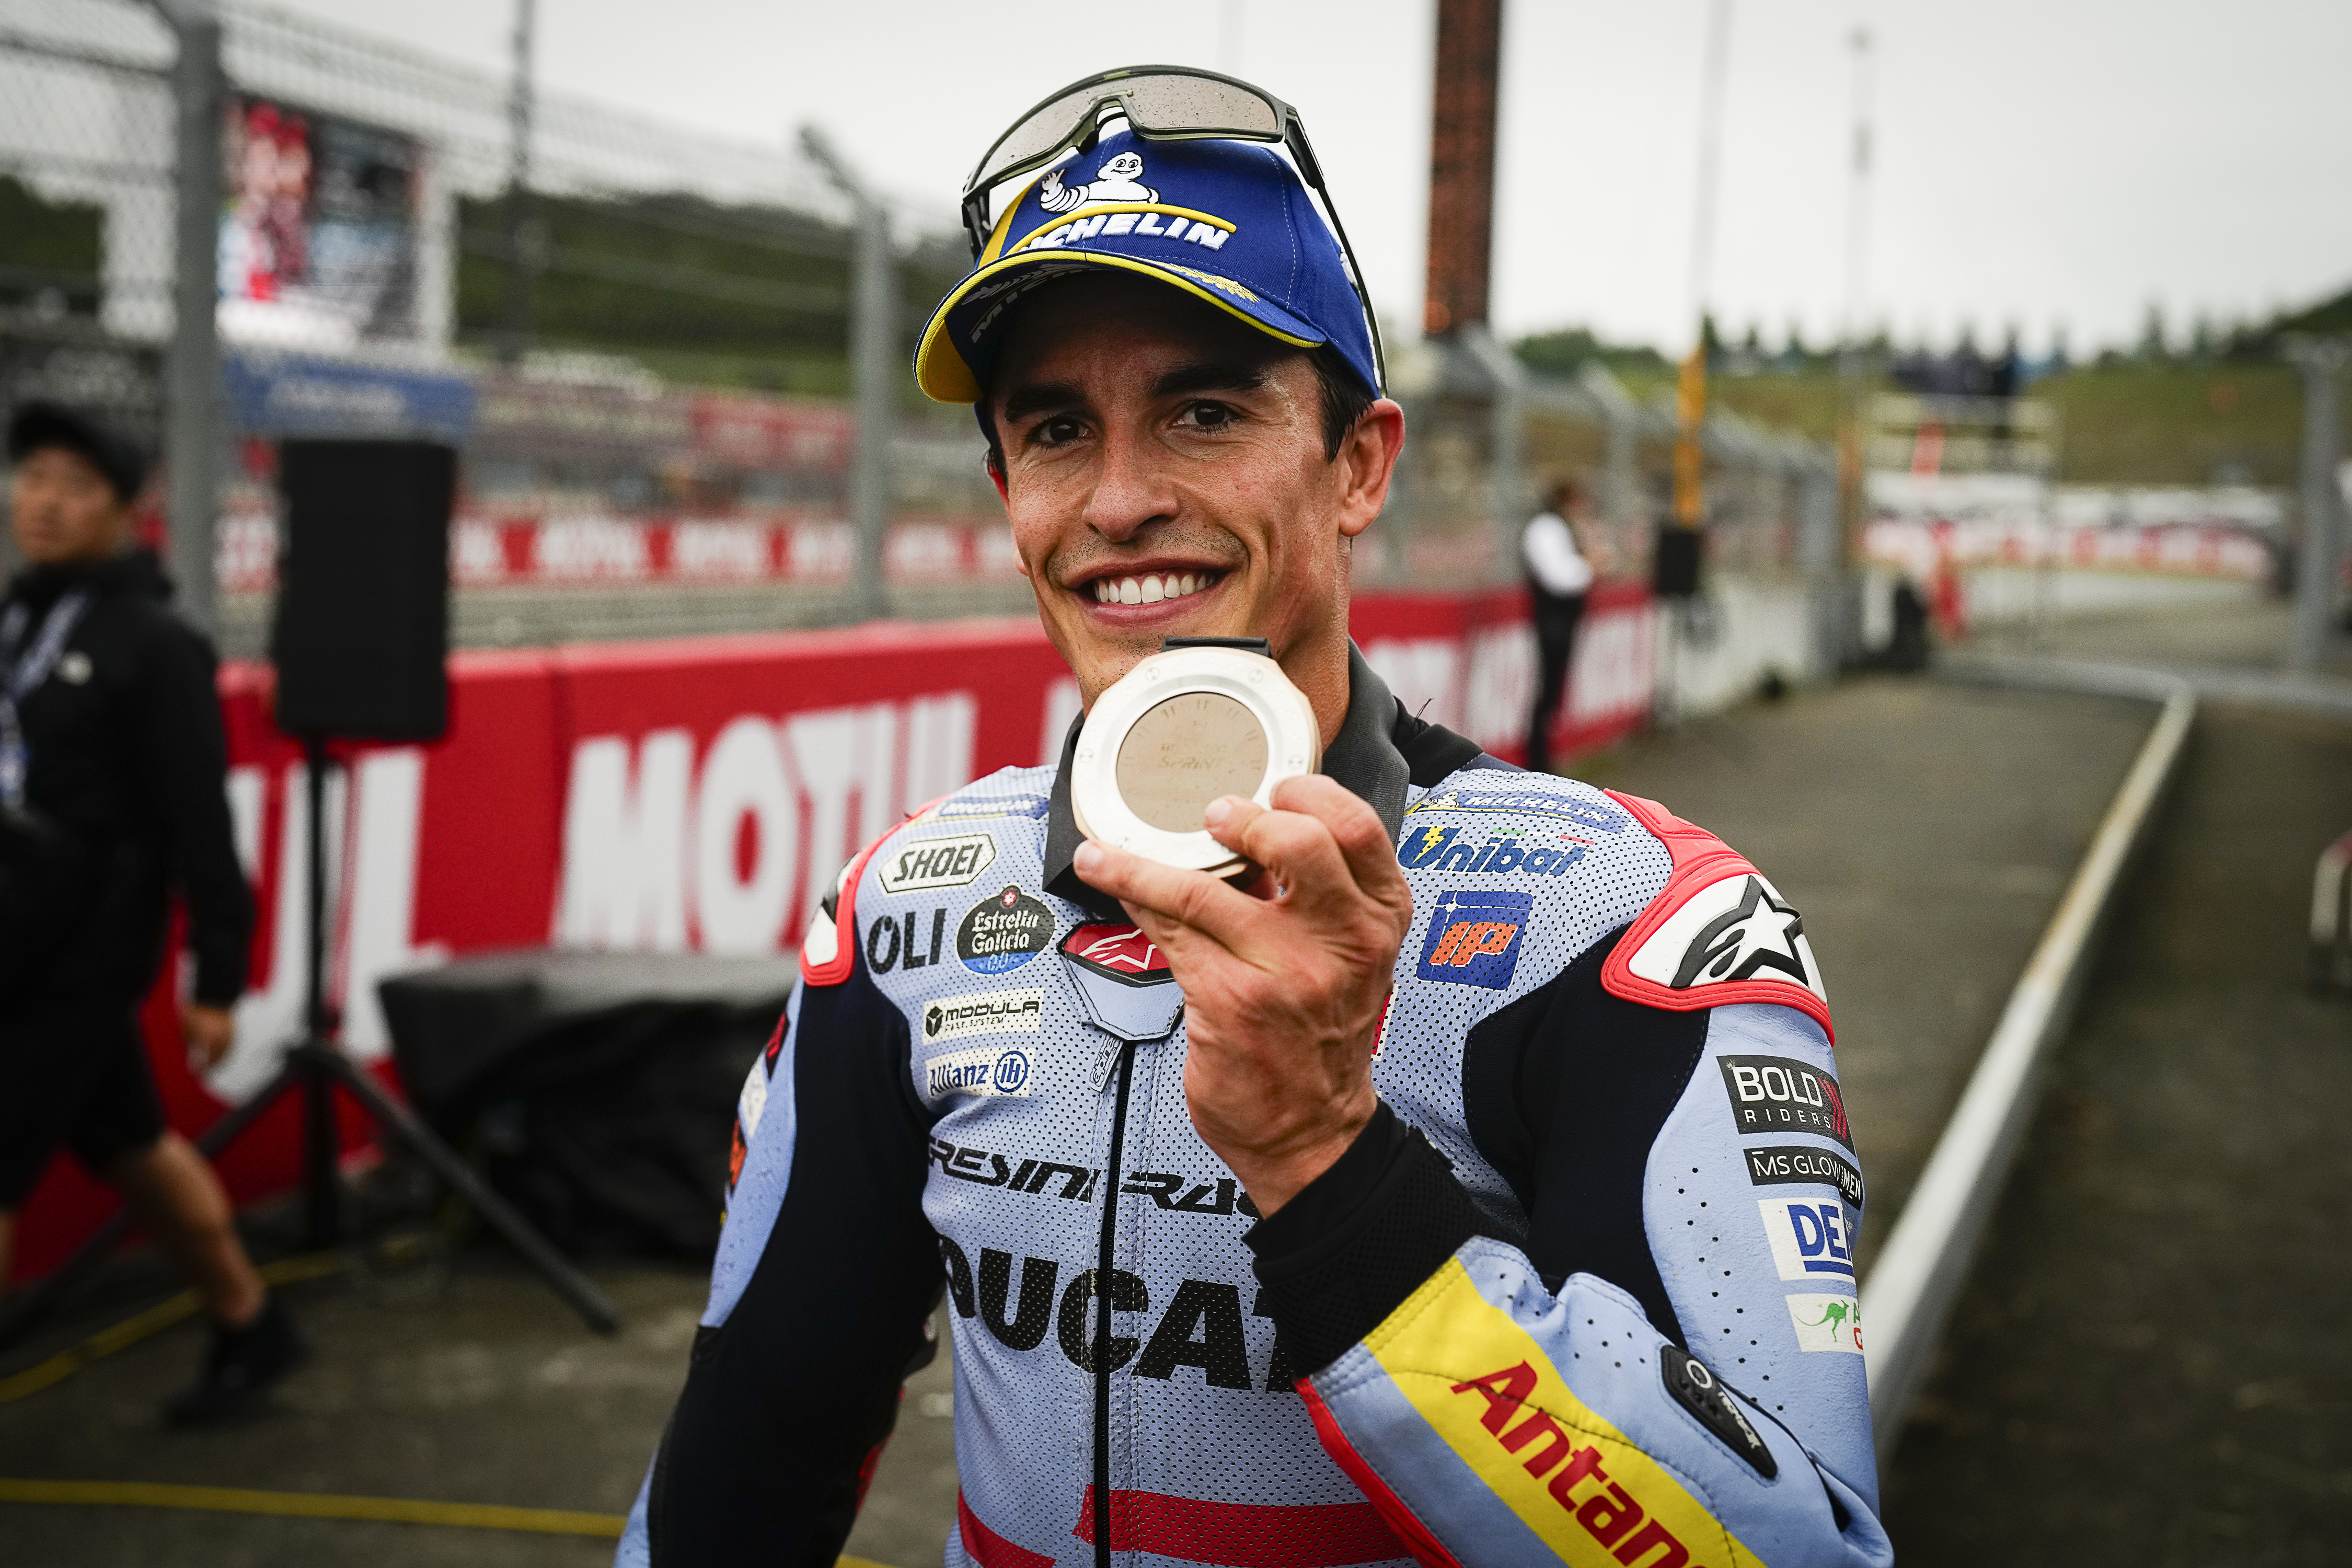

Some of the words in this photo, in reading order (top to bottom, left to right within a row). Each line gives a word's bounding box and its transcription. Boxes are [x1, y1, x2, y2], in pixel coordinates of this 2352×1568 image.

[1018, 213, 1229, 251] ICHELIN
[1465, 797, 1609, 822] MICHELIN
[893, 844, 983, 882] SHOEI
[1398, 826, 1589, 878] Unibat
[972, 910, 1039, 932] Estrella
[972, 929, 1030, 954] Galicia
[946, 1001, 1039, 1021] MODULA
[930, 1062, 989, 1097] Allianz
[1733, 1066, 1823, 1107] BOLD
[1744, 1109, 1831, 1128] RIDERS
[928, 1135, 1101, 1203] RESINI
[1752, 1151, 1790, 1176] MS
[1794, 1156, 1841, 1181] GLOW
[1787, 1204, 1852, 1262] DE
[1450, 1360, 1707, 1568] Antan
